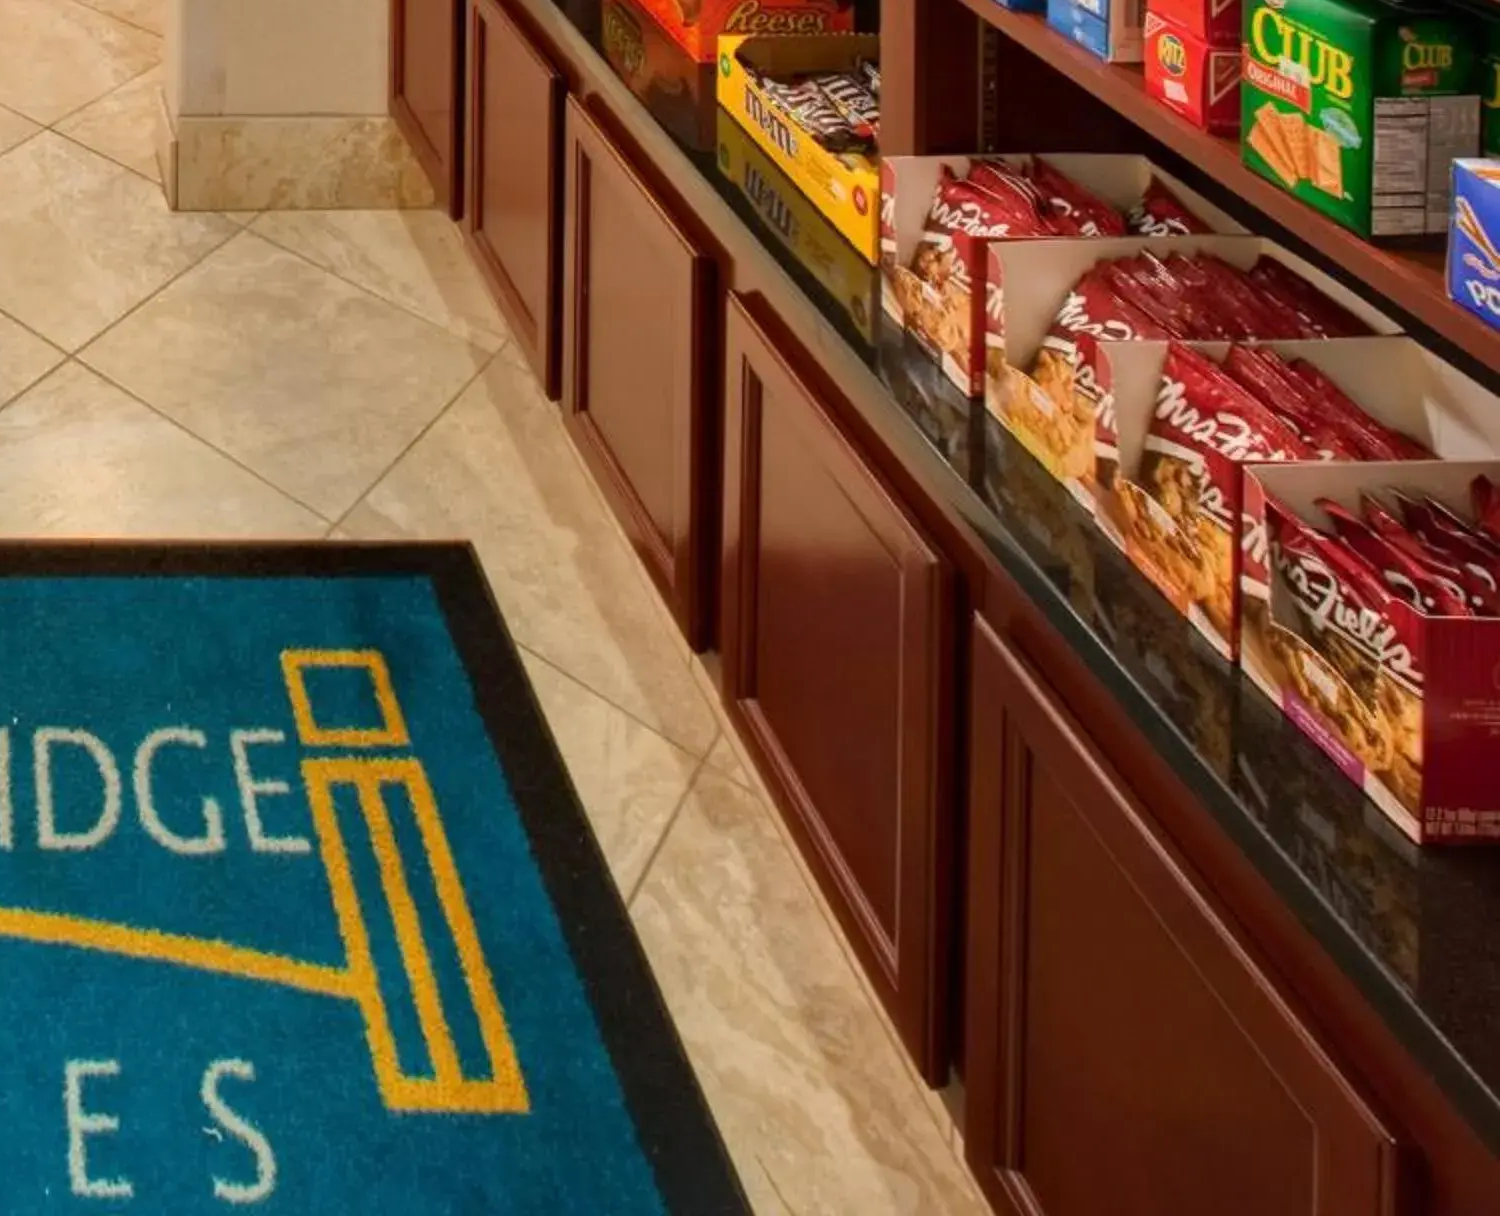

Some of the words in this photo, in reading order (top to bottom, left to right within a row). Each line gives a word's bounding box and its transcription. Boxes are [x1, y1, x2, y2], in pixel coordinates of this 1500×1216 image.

[1157, 36, 1185, 68] RITZ
[1251, 5, 1355, 100] CLUB
[1403, 43, 1453, 70] CLUB
